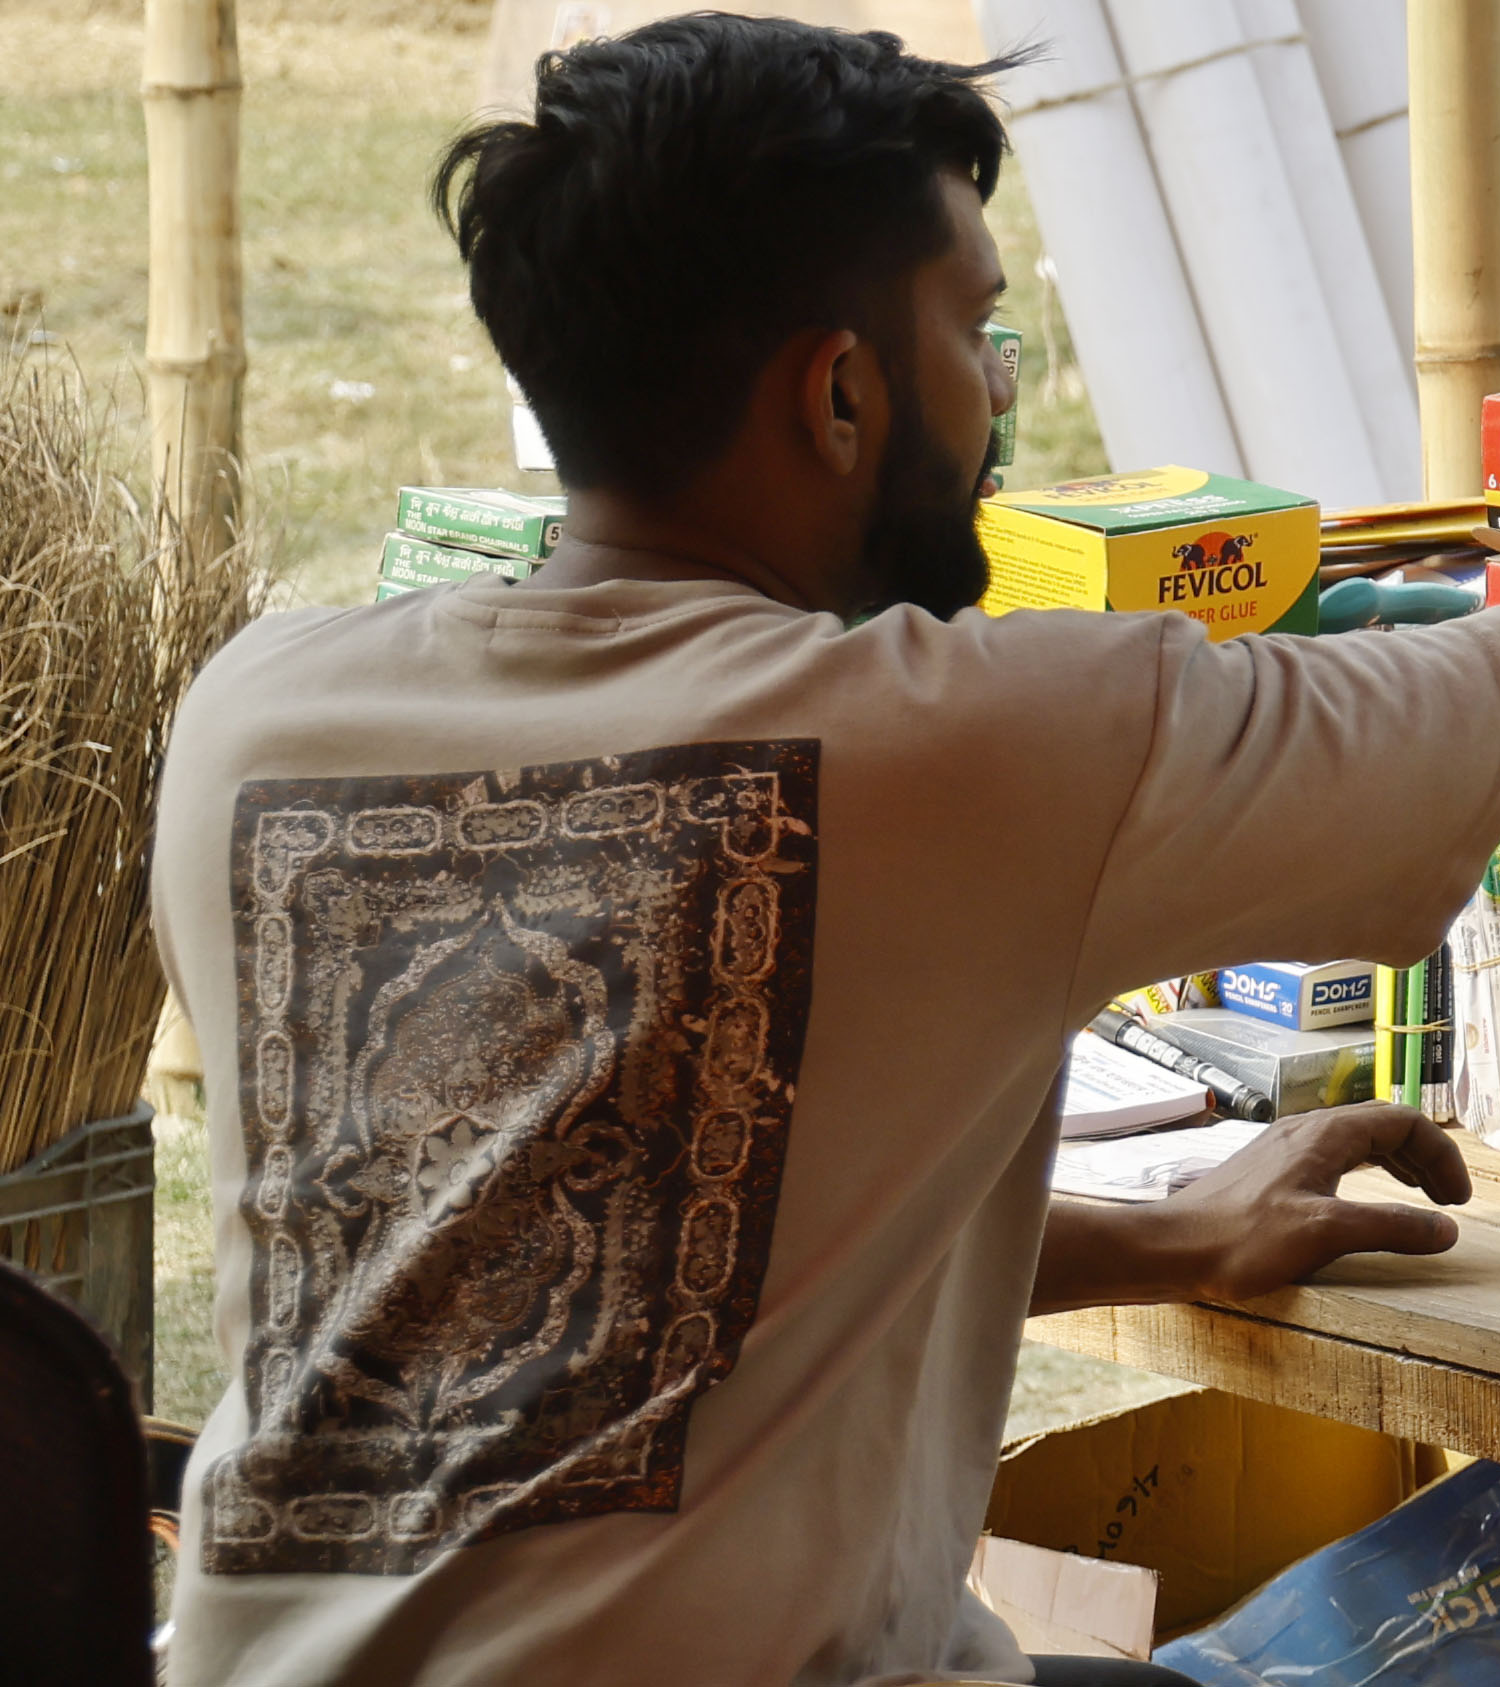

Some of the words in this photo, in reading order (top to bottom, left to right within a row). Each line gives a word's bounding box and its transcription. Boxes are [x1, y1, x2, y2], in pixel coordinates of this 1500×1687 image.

[407, 510, 422, 521] THE
[1158, 562, 1268, 604] FEVICOL
[1223, 969, 1279, 1002] DOMS
[1315, 979, 1368, 1002] DOMS
